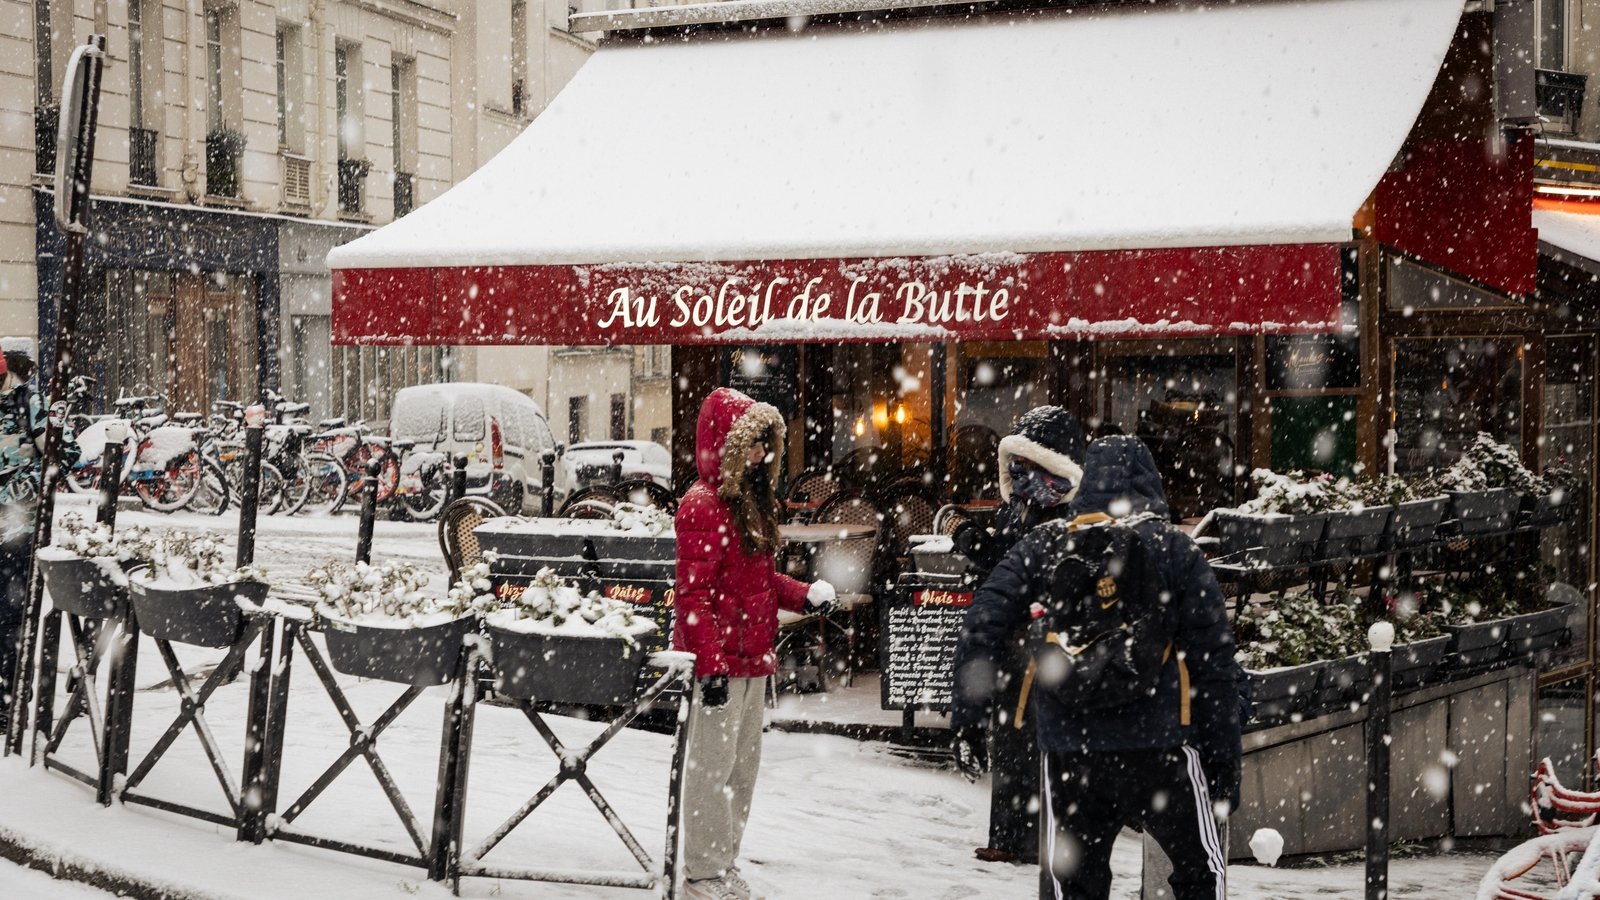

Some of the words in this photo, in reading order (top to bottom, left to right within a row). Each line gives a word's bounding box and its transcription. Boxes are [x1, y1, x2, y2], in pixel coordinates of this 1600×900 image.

[597, 286, 660, 329] Au
[670, 276, 790, 329] Soleil
[787, 277, 832, 323] de
[843, 275, 884, 324] la
[896, 280, 1010, 325] Butte
[609, 583, 646, 602] Pâtes
[920, 588, 954, 608] Plats
[889, 606, 910, 617] Confit
[917, 606, 943, 617] Canard
[888, 624, 915, 633] Tartare
[889, 662, 911, 671] Poulet
[912, 662, 937, 671] Fermier
[889, 686, 905, 695] Fish
